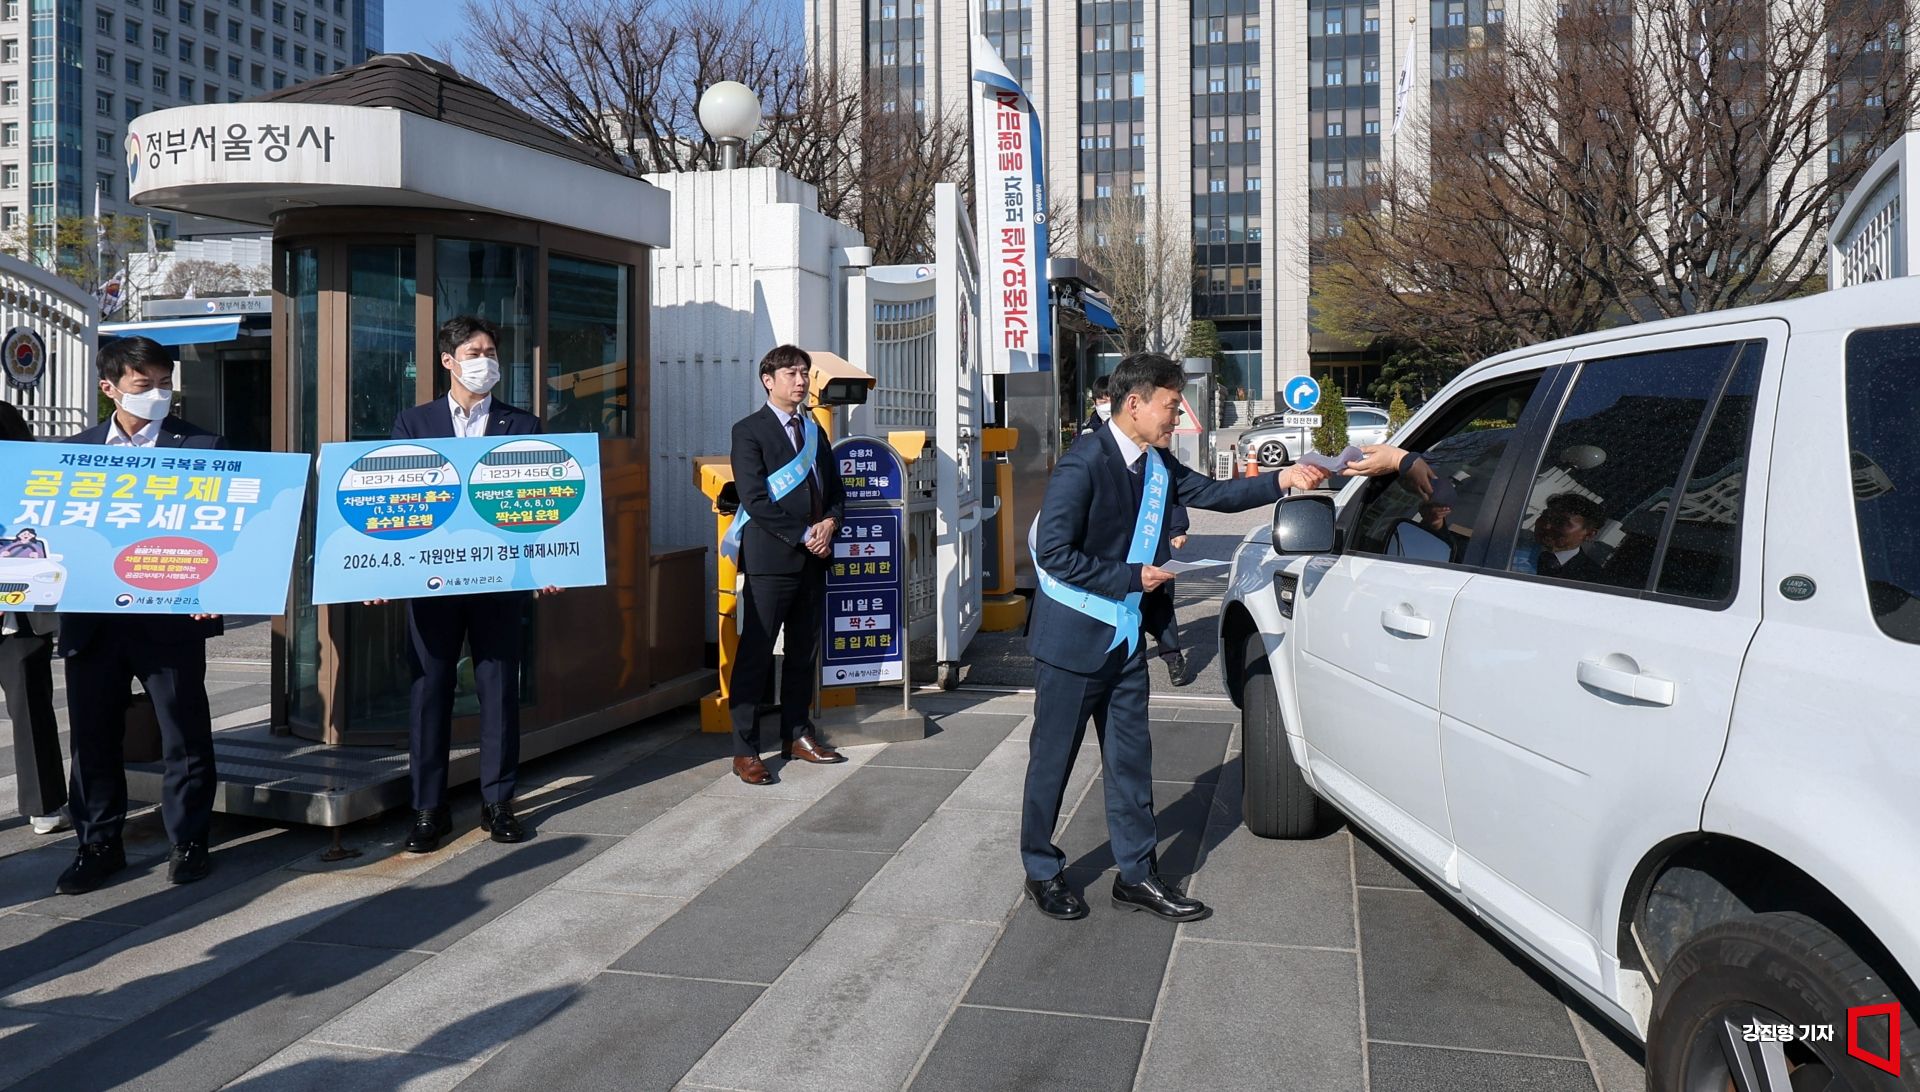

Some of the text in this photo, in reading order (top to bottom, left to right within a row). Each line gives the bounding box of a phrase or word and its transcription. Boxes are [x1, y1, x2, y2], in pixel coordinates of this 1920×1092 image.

[146, 123, 335, 169] 정부서울청사
[996, 91, 1029, 348] 국가중요시설 보행자 통행금지
[219, 300, 261, 311] 정부서울청사
[849, 449, 873, 458] 승용차
[59, 453, 242, 472] 자원안보위기 극복을 위해
[843, 461, 877, 473] 2부제
[361, 474, 394, 485] 123가
[489, 469, 520, 479] 123가
[24, 470, 261, 503] 공공2부제를
[842, 476, 889, 488] 짝제 적용
[344, 491, 455, 506] 차량번호 끝자리 홀수:
[475, 486, 578, 500] 차량번호 끝자리 짝수:
[373, 503, 429, 515] (1, 3, 5, 7, 9)
[500, 498, 555, 510] (2, 4, 6, 8, 0)
[1143, 472, 1164, 548] 지켜주세요!
[13, 499, 245, 531] 지켜주세요!
[495, 509, 560, 523] 짝수일 운행
[366, 515, 433, 530] 홀수일 운행
[841, 524, 883, 538] 오늘은
[343, 553, 405, 570] 2026.4.8.
[419, 548, 467, 565] 자원안보
[470, 546, 493, 562] 위기
[497, 545, 520, 561] 경보
[523, 541, 580, 559] 해제시까지
[849, 544, 876, 556] 홀수
[834, 561, 891, 576] 출입제한
[445, 575, 503, 587] 서울청사관리소
[136, 597, 200, 605] 서울청사관리소
[841, 598, 883, 612] 내일은
[849, 617, 876, 629] 짝수
[834, 634, 891, 650] 출입제한
[848, 669, 890, 678] 서울청사관리소
